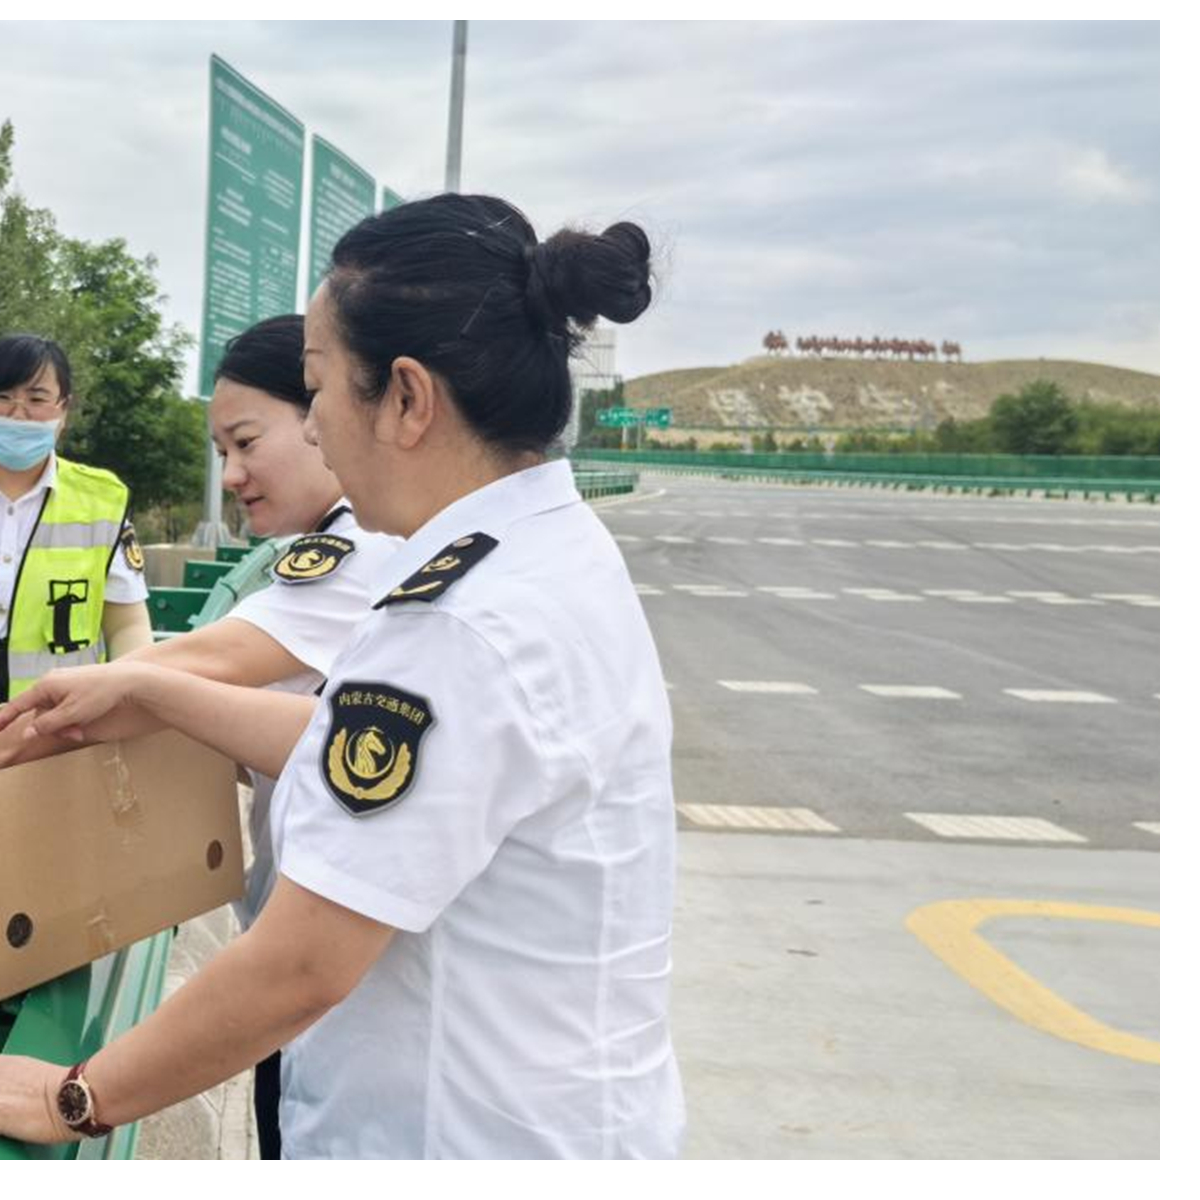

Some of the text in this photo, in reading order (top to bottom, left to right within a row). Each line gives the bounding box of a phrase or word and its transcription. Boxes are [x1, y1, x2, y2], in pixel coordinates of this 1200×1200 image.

[338, 690, 426, 727] 内蒙古交通集团
